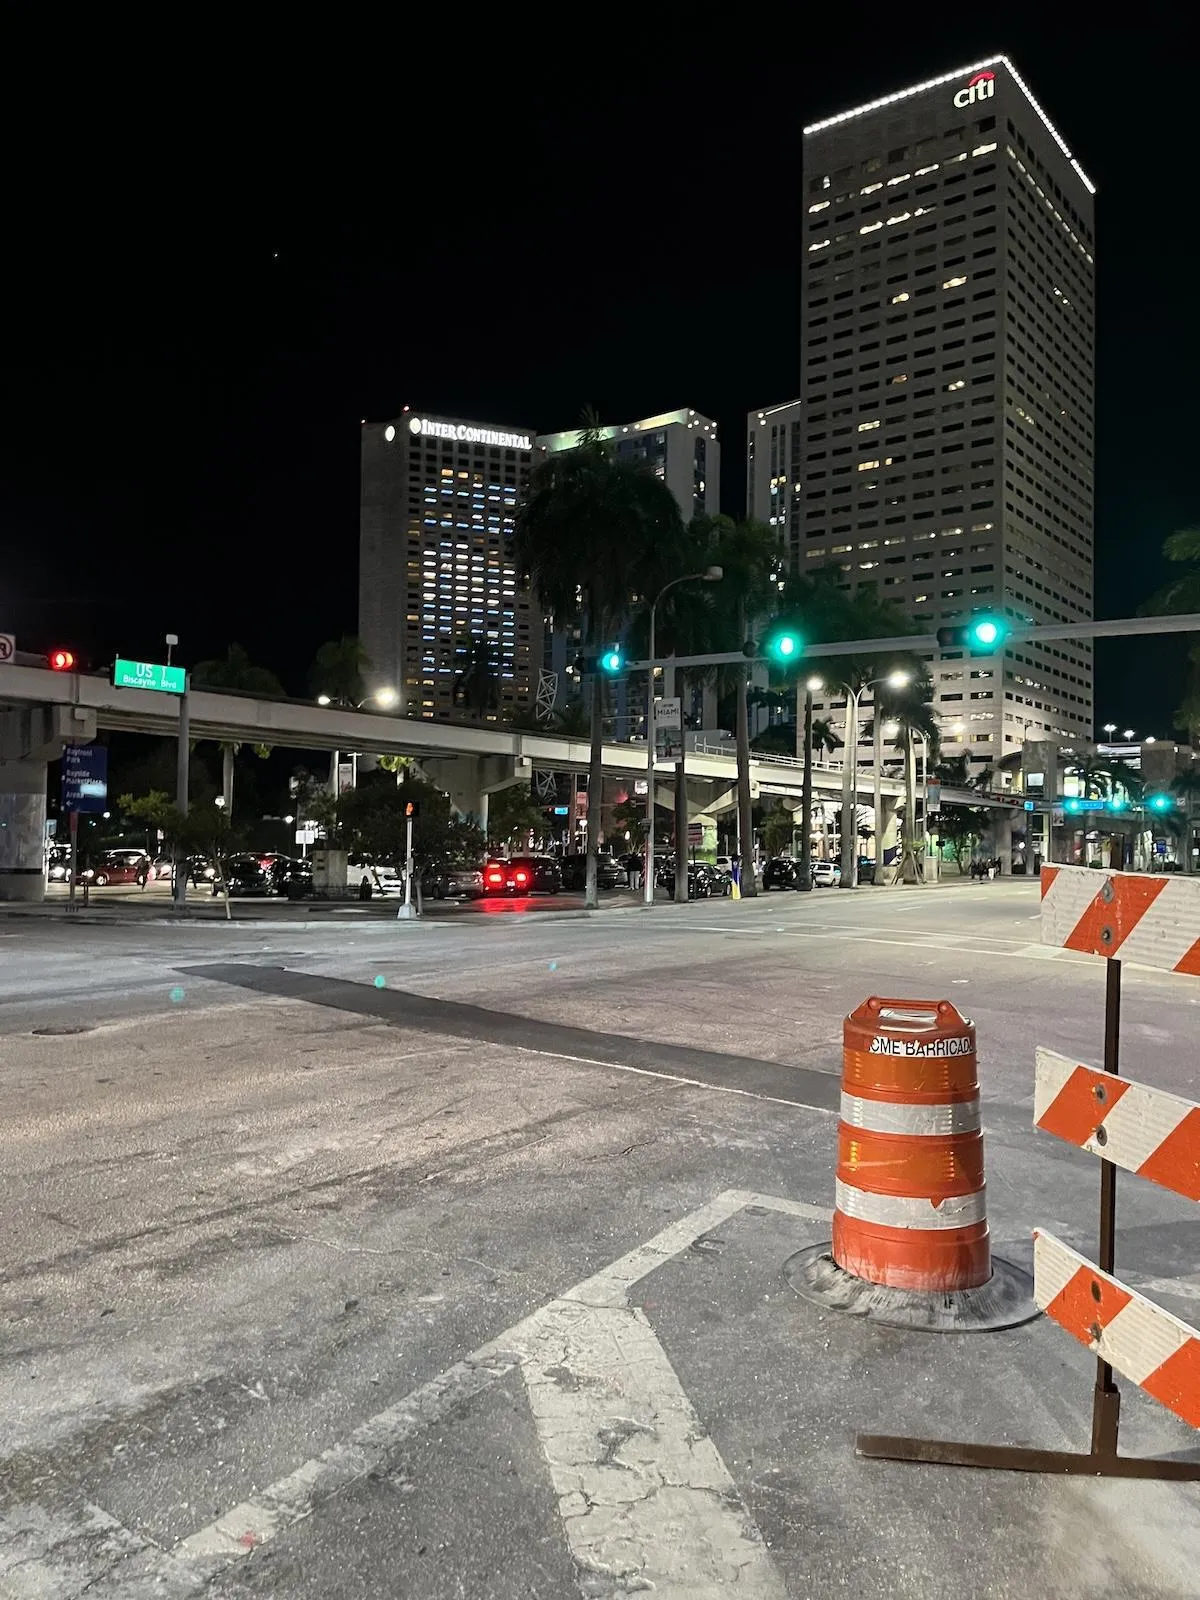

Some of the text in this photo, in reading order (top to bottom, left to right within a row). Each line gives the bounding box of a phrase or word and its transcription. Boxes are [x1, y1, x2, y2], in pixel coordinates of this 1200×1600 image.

[953, 75, 995, 108] citi
[136, 663, 153, 678] US
[123, 674, 176, 689] Biscayne Blvd
[657, 707, 680, 716] MIAMI
